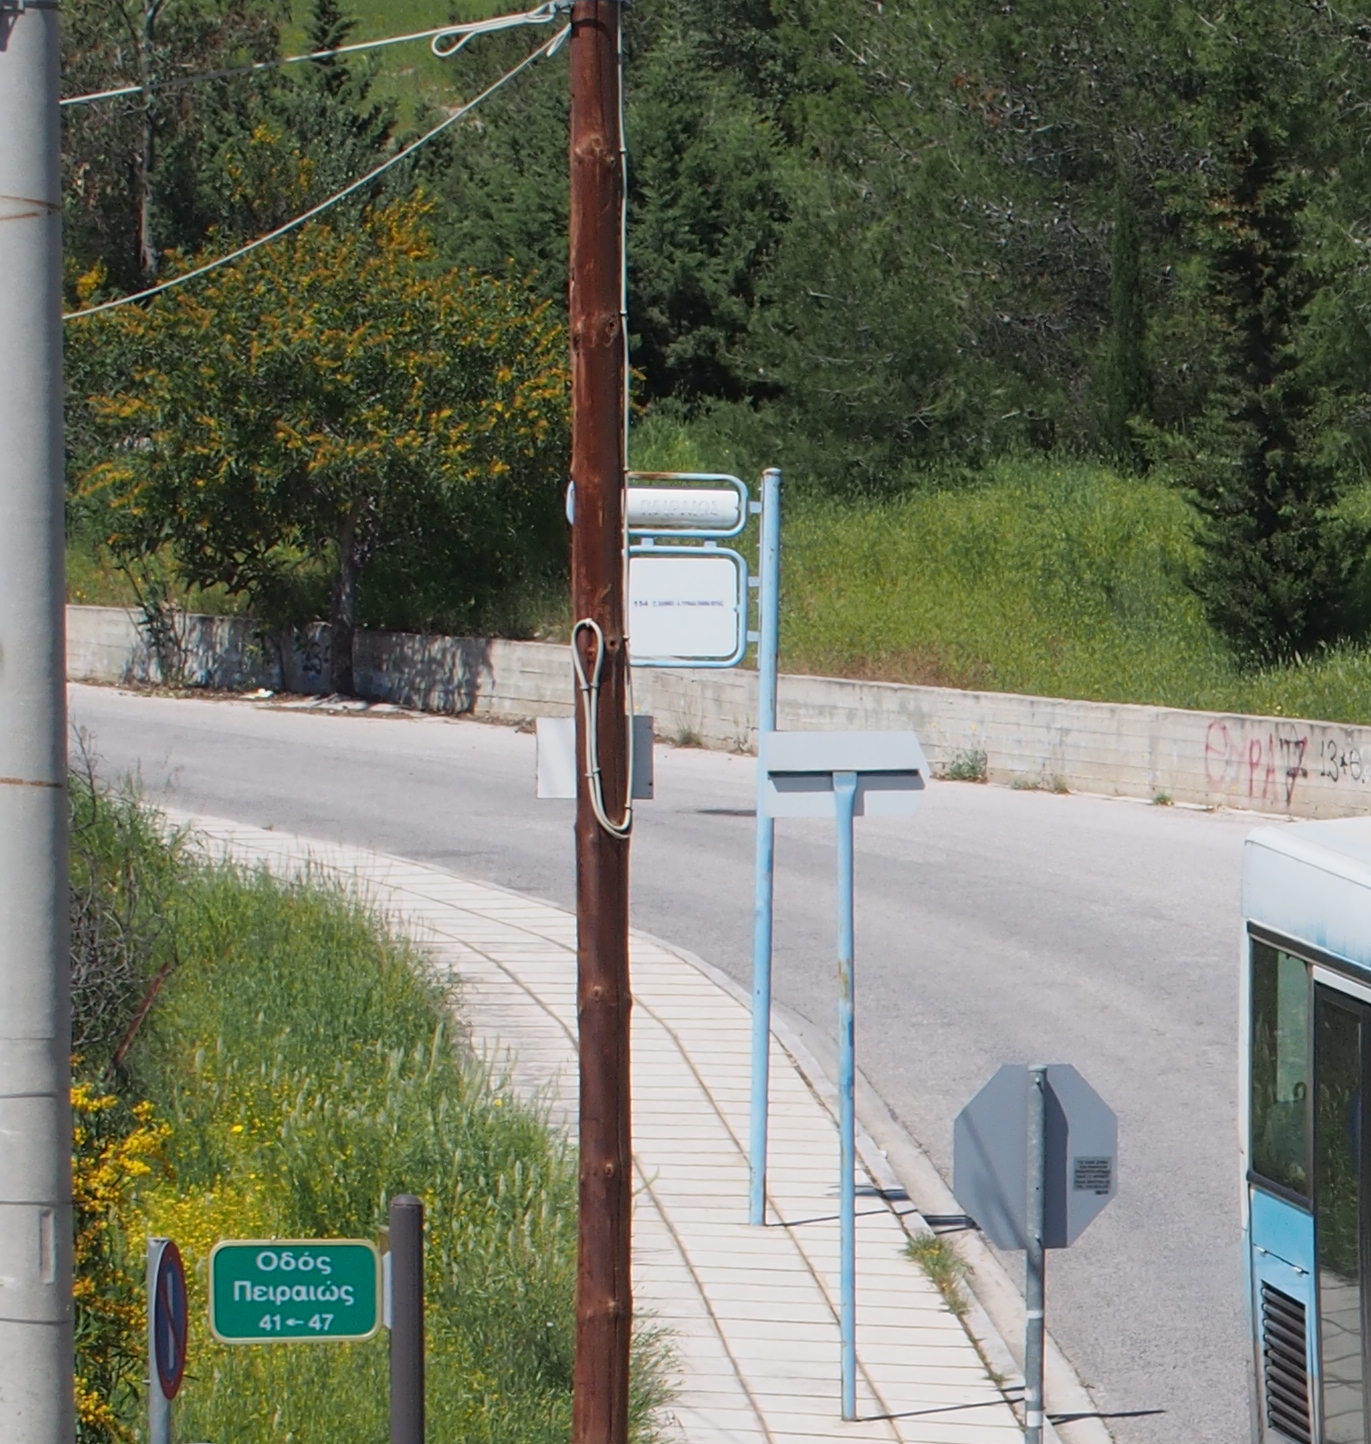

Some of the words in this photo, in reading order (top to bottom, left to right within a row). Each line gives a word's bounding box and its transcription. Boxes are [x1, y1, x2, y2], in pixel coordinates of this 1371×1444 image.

[256, 1251, 332, 1274] Οδός
[233, 1280, 354, 1305] Πειραιώς
[259, 1315, 281, 1331] 41
[307, 1314, 334, 1331] 47
